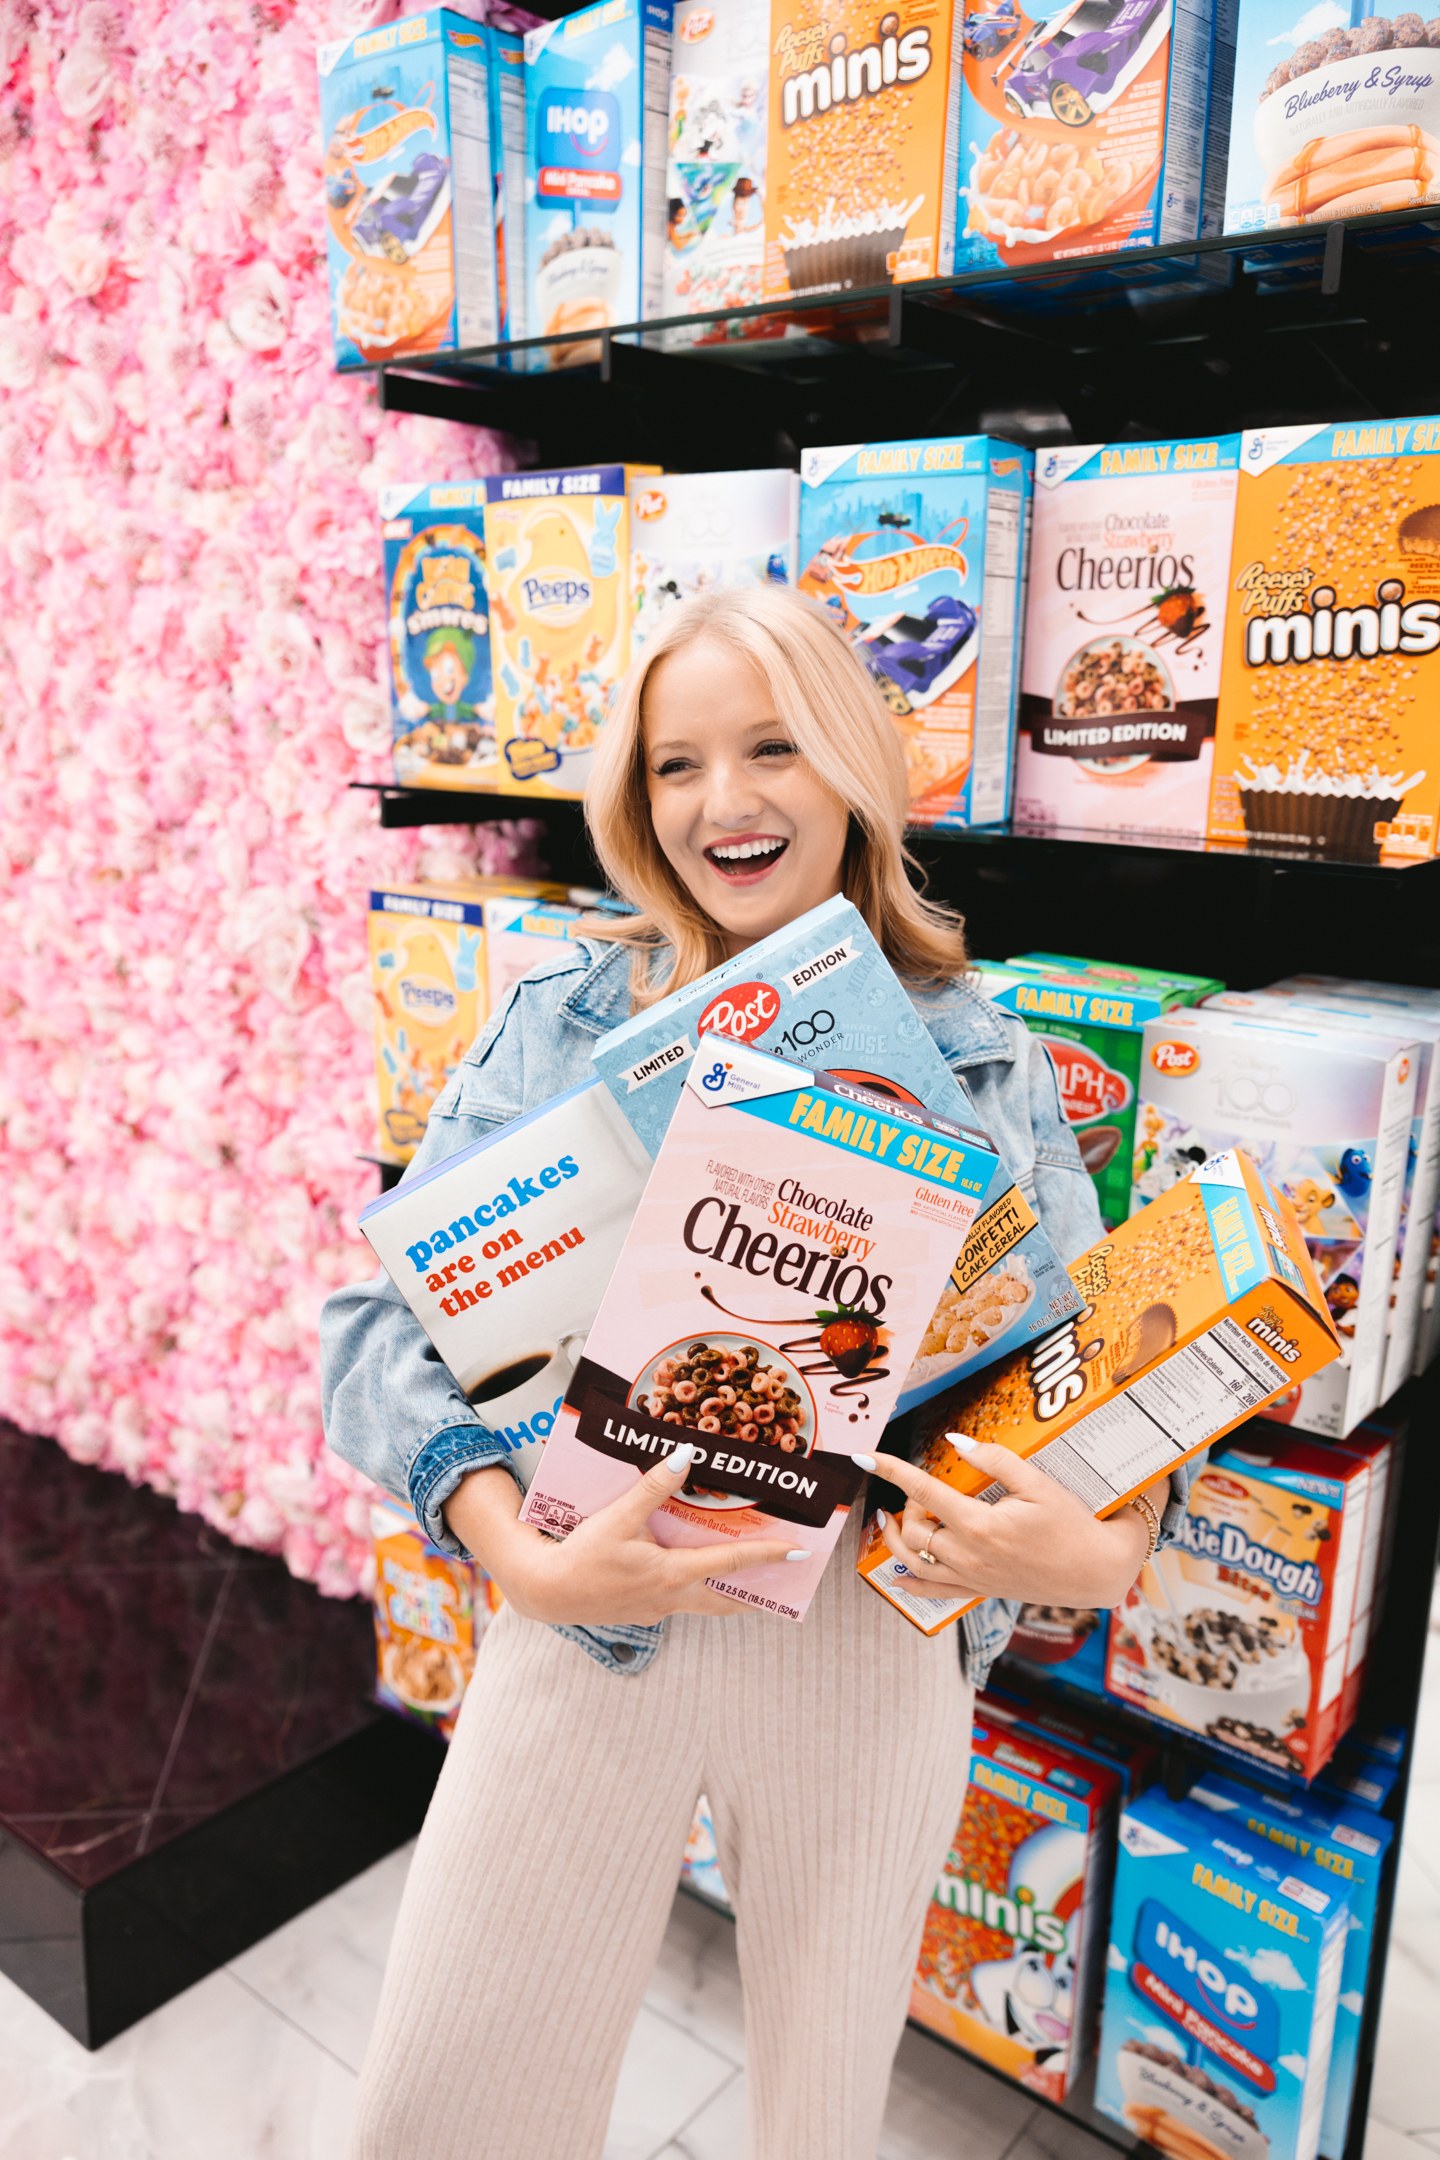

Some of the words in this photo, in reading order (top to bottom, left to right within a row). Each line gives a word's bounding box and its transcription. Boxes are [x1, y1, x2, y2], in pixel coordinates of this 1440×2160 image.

[783, 12, 932, 128] minis
[1284, 79, 1362, 120] Blueberry
[1365, 67, 1382, 89] &
[1381, 65, 1434, 96] Syrup
[857, 447, 922, 475] FAMILY
[923, 444, 965, 471] SIZE
[1101, 446, 1170, 475] FAMILY
[1173, 443, 1218, 469] SIZE
[1332, 425, 1410, 458] FAMILY
[1412, 422, 1440, 452] SIZ
[502, 478, 558, 499] FAMILY
[562, 474, 602, 495] SIZE
[1104, 512, 1170, 532] Chocolate
[1056, 546, 1195, 592] Cheerios
[1237, 562, 1315, 591] Reese's
[522, 577, 592, 611] Peeps
[1242, 588, 1306, 615] Puffs
[1246, 580, 1440, 668] minis
[1043, 724, 1112, 747] LIMITED
[1112, 722, 1187, 743] EDITION
[792, 948, 848, 987] EDITION
[400, 980, 455, 1009] Peeps
[700, 988, 777, 1036] Post
[1016, 986, 1087, 1019] FAMILY
[1088, 998, 1135, 1027] SIZE
[781, 1009, 835, 1052] 100
[798, 1031, 844, 1063] WONDER
[633, 1045, 685, 1081] LIMITED
[1156, 1044, 1194, 1068] Post
[727, 1080, 745, 1093] Mills
[730, 1073, 761, 1090] General
[788, 1092, 901, 1158] FAMILY
[896, 1134, 966, 1183] SIZE
[972, 1182, 983, 1193] OZ
[706, 1159, 738, 1183] FLAVORED
[737, 1171, 755, 1187] WITH
[754, 1175, 775, 1196] OTHER
[713, 1178, 741, 1200] NATURAL
[740, 1188, 770, 1210] FLAVORS
[405, 1155, 580, 1273] pancakes
[777, 1178, 874, 1232] Chocolate
[915, 1186, 951, 1210] Gluten
[952, 1199, 975, 1218] Free
[982, 1197, 1012, 1228] FLAVORED
[767, 1200, 878, 1263] Strawberry
[955, 1206, 1020, 1271] CONFETTI
[1210, 1196, 1248, 1251] FAMILY
[424, 1255, 475, 1292] are
[481, 1228, 524, 1261] on
[439, 1279, 493, 1318] the
[495, 1226, 586, 1288] menu
[682, 1196, 894, 1318] Cheerios
[961, 1255, 989, 1283] CAKE
[988, 1222, 1026, 1259] CEREAL
[1028, 1323, 1038, 1333] 16
[1036, 1318, 1046, 1328] OZ
[1063, 1300, 1079, 1312] 453g
[1048, 1298, 1062, 1311] NET
[1062, 1291, 1074, 1303] WT
[1222, 1318, 1241, 1338] Nutrition
[1239, 1335, 1252, 1350] Facts
[1252, 1347, 1265, 1361] Datos
[1263, 1358, 1271, 1367] de
[1246, 1317, 1302, 1363] minis
[1032, 1302, 1105, 1422] inis
[1228, 1379, 1243, 1392] 160
[1242, 1392, 1258, 1406] 200
[496, 1395, 564, 1454] IHO
[603, 1418, 708, 1465] LIMITD
[711, 1451, 818, 1499] EDITION
[533, 1501, 546, 1512] 140
[535, 1491, 544, 1499] PER
[557, 1500, 576, 1511] SERVING
[668, 1504, 688, 1520] Whole
[688, 1512, 707, 1526] Grain
[707, 1519, 720, 1530] Oat
[719, 1523, 741, 1538] Cereal
[1220, 1526, 1318, 1600] Dough
[710, 1580, 715, 1588] 1
[716, 1581, 726, 1592] LB
[726, 1585, 738, 1596] 2.5
[738, 1590, 748, 1599] OZ
[747, 1593, 765, 1606] (18.5
[765, 1599, 778, 1611] OZ)
[777, 1605, 800, 1620] (524g)
[1248, 1818, 1311, 1857] FAMILY
[1315, 1847, 1355, 1880] SIZE
[1192, 1863, 1258, 1914] FAMILY
[1258, 1899, 1300, 1938] SIZE
[1144, 1974, 1184, 2015] Mini
